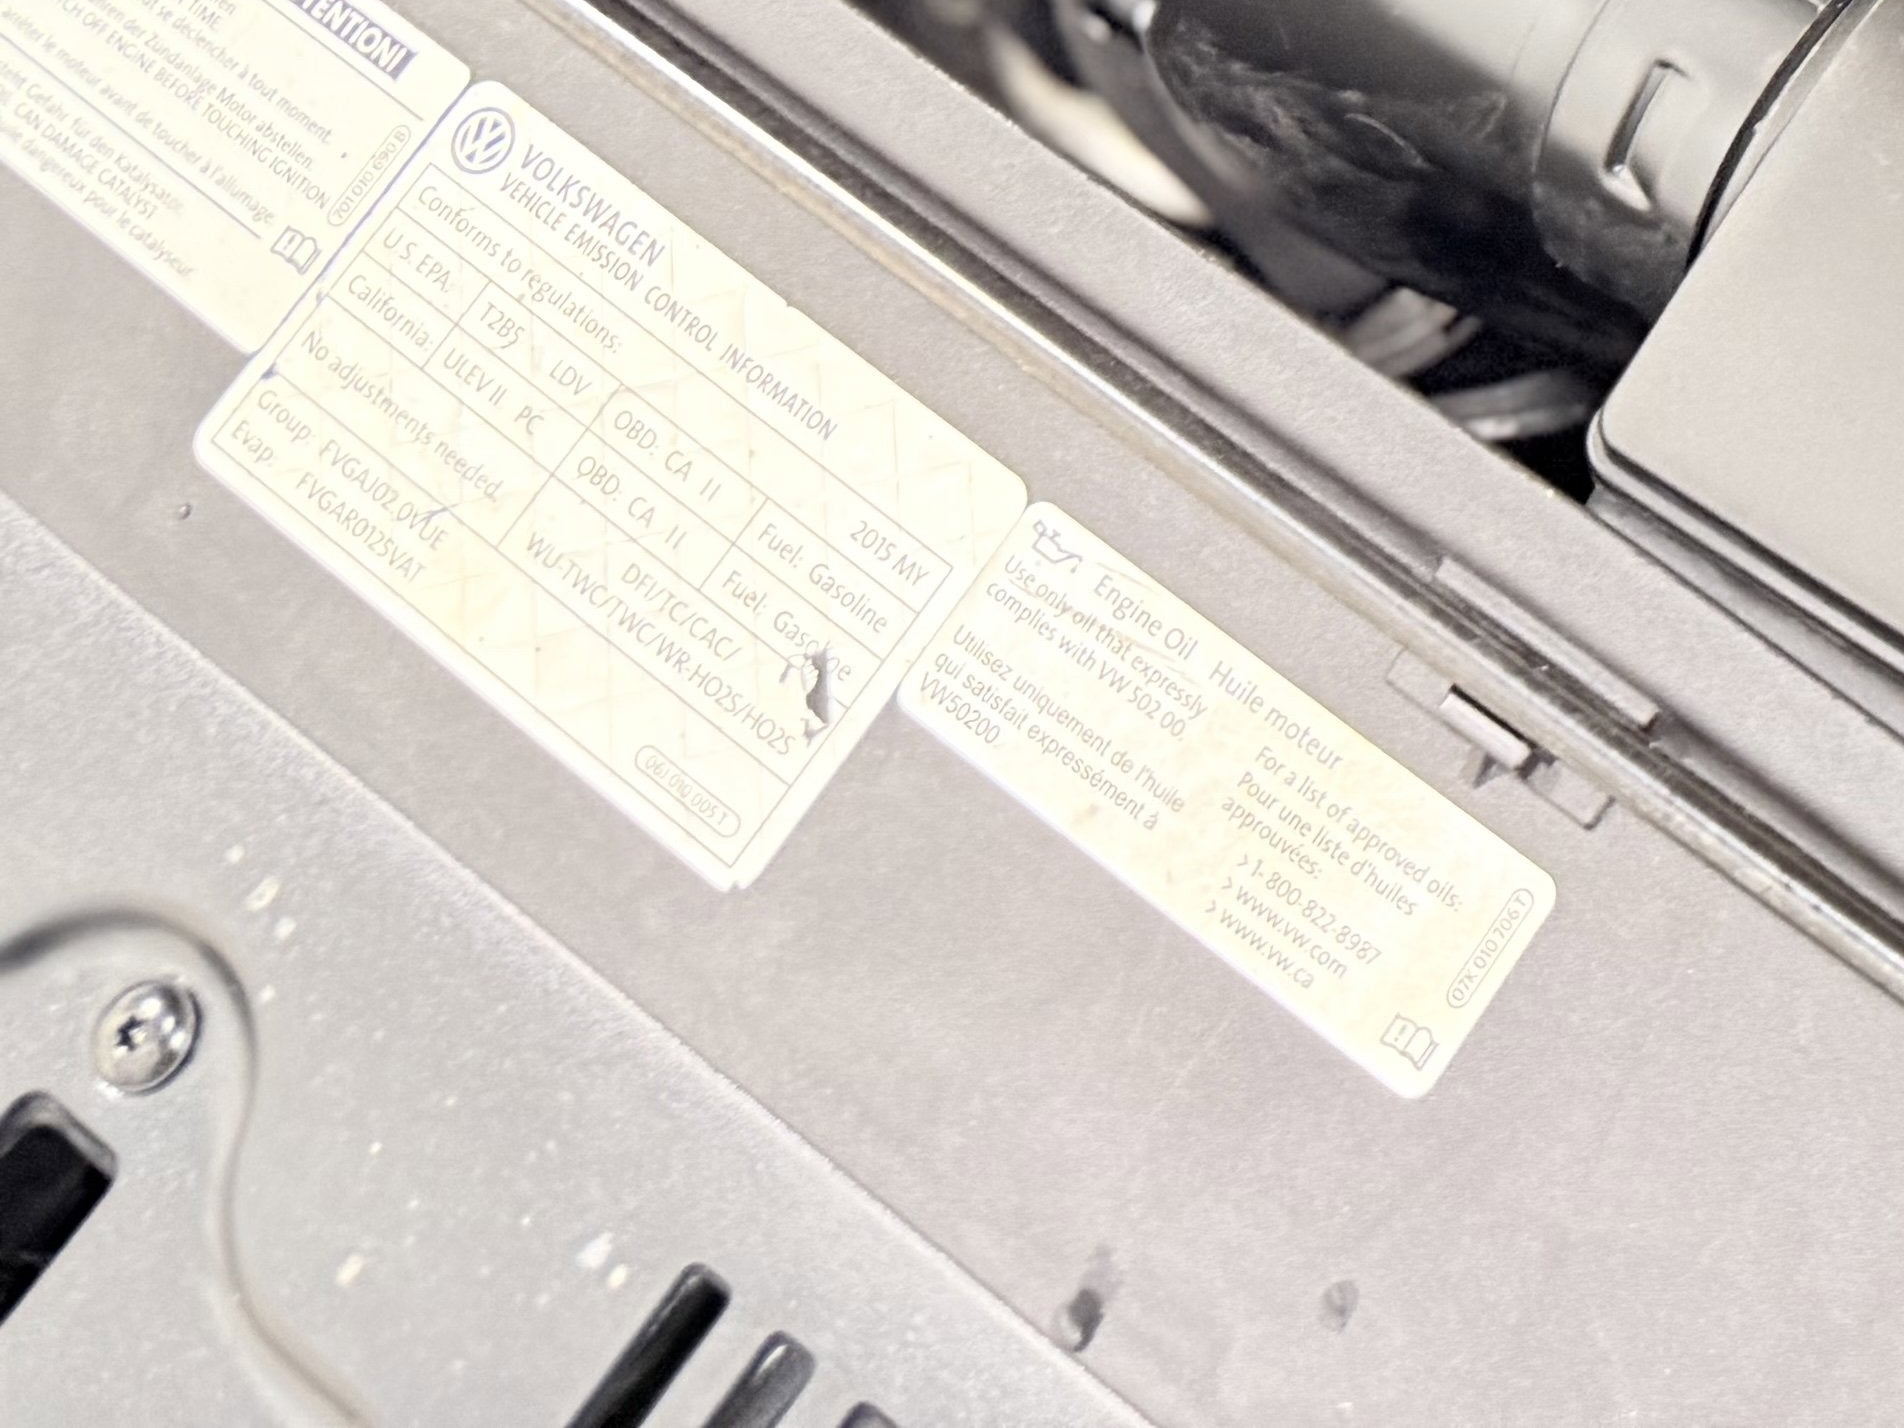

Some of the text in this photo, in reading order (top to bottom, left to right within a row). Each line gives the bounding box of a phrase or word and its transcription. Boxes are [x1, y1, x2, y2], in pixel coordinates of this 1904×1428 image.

[40, 33, 61, 56] le
[53, 44, 104, 90] moteur
[97, 79, 139, 117] avant
[132, 105, 157, 131] de
[149, 119, 205, 168] toucher
[121, 13, 149, 41] der
[213, 84, 261, 127] Motor
[253, 115, 321, 173] abstellen.
[155, 4, 174, 24] se
[246, 70, 279, 102] tout
[12, 100, 45, 131] CAN
[38, 122, 100, 175] DAMAGE
[94, 165, 159, 221] CATALYST
[23, 79, 73, 124] Gefahr
[66, 113, 95, 143] für
[87, 130, 118, 161] den
[79, 8, 109, 38] OFF
[103, 28, 157, 75] ENGINE
[151, 64, 205, 111] BEFORE
[199, 101, 274, 164] TOUCHING
[265, 153, 333, 211] IGNITION
[16, 133, 91, 199] dangereux
[81, 189, 117, 223] pour
[114, 208, 135, 231] le
[511, 142, 670, 269] VOLKSWAGEN
[343, 271, 440, 353] California:
[413, 181, 630, 359] Conforms to regulations:
[495, 171, 841, 442] VEHICLE EMISSION CONTROL INFORMATION
[440, 346, 495, 397] ULEV
[512, 402, 546, 437] PC
[474, 300, 593, 400] T2B5 LDV
[225, 417, 283, 472] Evap:
[250, 385, 322, 451] Group:
[298, 328, 510, 505] No adjustments needed.
[609, 406, 665, 457] OBD:
[660, 446, 697, 483] CA
[571, 451, 628, 504] OBD:
[623, 492, 660, 529] CA
[755, 520, 894, 637] Fuel: Gasoline
[847, 517, 930, 590] 2015 MY
[618, 560, 744, 667] DFI/TC/CAC/
[719, 567, 859, 685] Fuel: Gasone
[981, 575, 1062, 647] complies
[1055, 629, 1100, 673] with
[1093, 659, 1132, 698] VW
[1125, 684, 1164, 722] 502
[1001, 552, 1211, 725] Use only oil that expressly
[1087, 570, 1199, 662] Engine Oil
[930, 646, 966, 684] qui
[960, 668, 1031, 731] satisfait
[1022, 718, 1148, 823] expressément
[949, 622, 1189, 816] Utilisez uniquement de l'huile
[1207, 658, 1347, 774] Huile moteur
[1216, 790, 1329, 886] approuvées:
[1235, 769, 1423, 919] Pour une liste d'huiles
[1252, 743, 1469, 914] For a list of approved oils:
[1215, 907, 1317, 992] www.vw.ca
[1232, 884, 1350, 981] www.vw.com
[1448, 966, 1479, 1004] 07K
[1469, 936, 1500, 972] 010
[1490, 904, 1522, 942] 706
